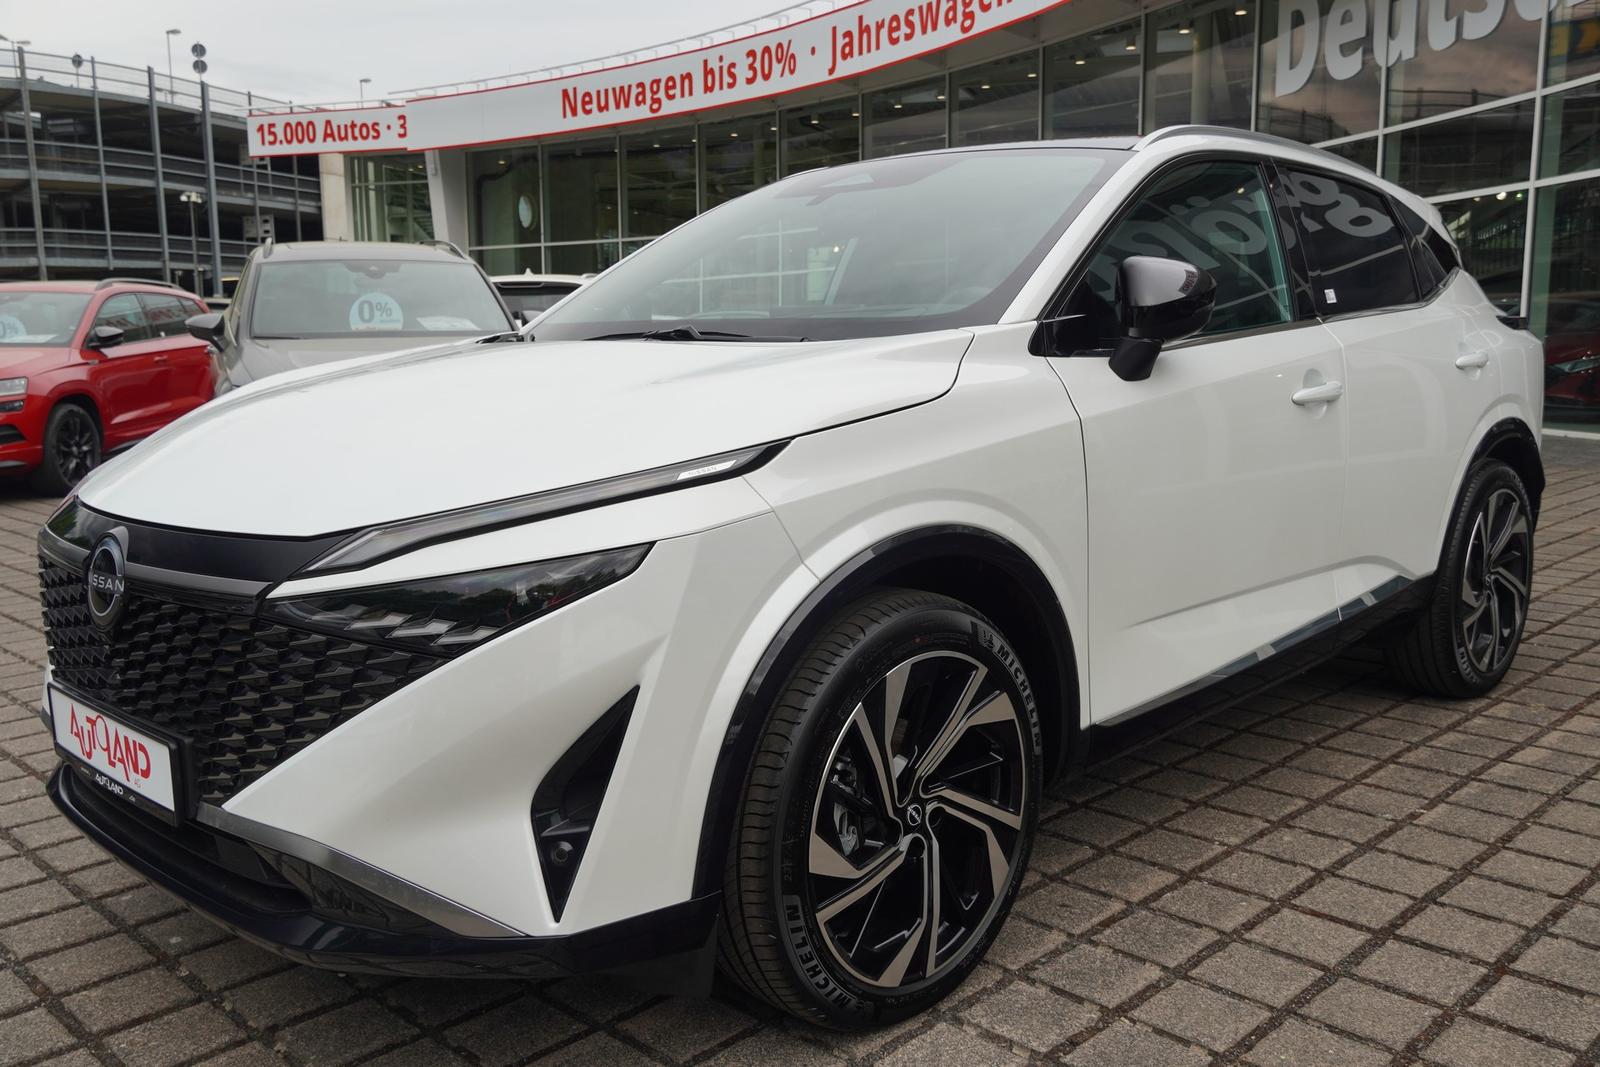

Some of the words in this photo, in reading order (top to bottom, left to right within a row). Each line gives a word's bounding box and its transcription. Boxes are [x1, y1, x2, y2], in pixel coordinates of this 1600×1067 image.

[561, 71, 694, 119] Neuwagen
[702, 55, 737, 94] bis
[745, 39, 797, 85] 30%
[828, 0, 1012, 76] Jahreswag
[256, 120, 317, 146] 15.000
[322, 119, 381, 143] Autos
[397, 114, 408, 139] 3
[358, 299, 393, 324] 0%
[90, 572, 125, 593] SSAN
[997, 644, 1040, 747] MICHELIN
[70, 702, 151, 782] AUTOLAND
[785, 904, 849, 1008] MICHELIN
